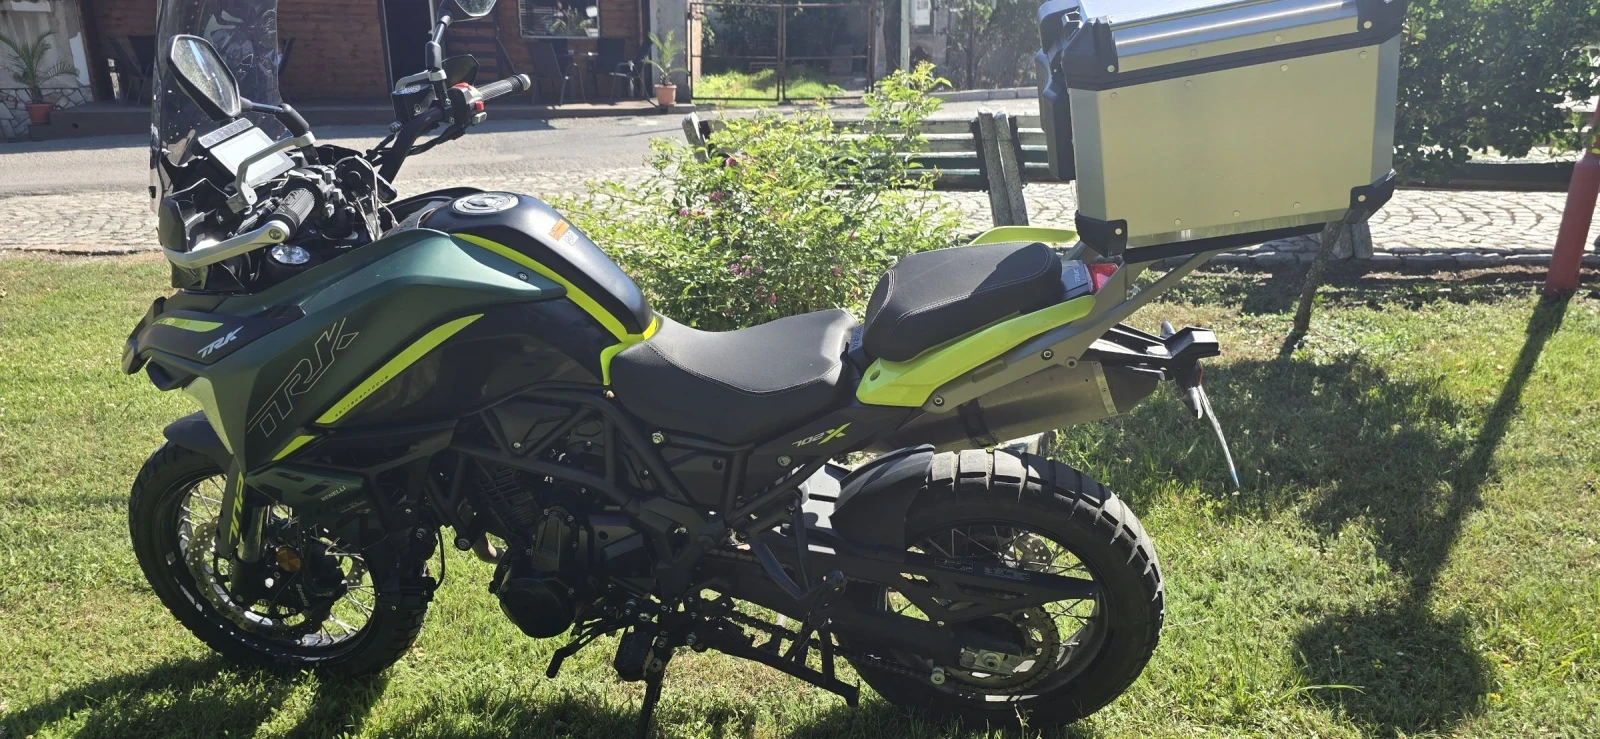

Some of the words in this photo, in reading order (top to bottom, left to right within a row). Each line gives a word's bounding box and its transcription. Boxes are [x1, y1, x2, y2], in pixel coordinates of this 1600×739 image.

[197, 325, 244, 359] TRK
[246, 317, 360, 438] TRK
[791, 421, 852, 447] 702X
[320, 485, 346, 502] BENELLI
